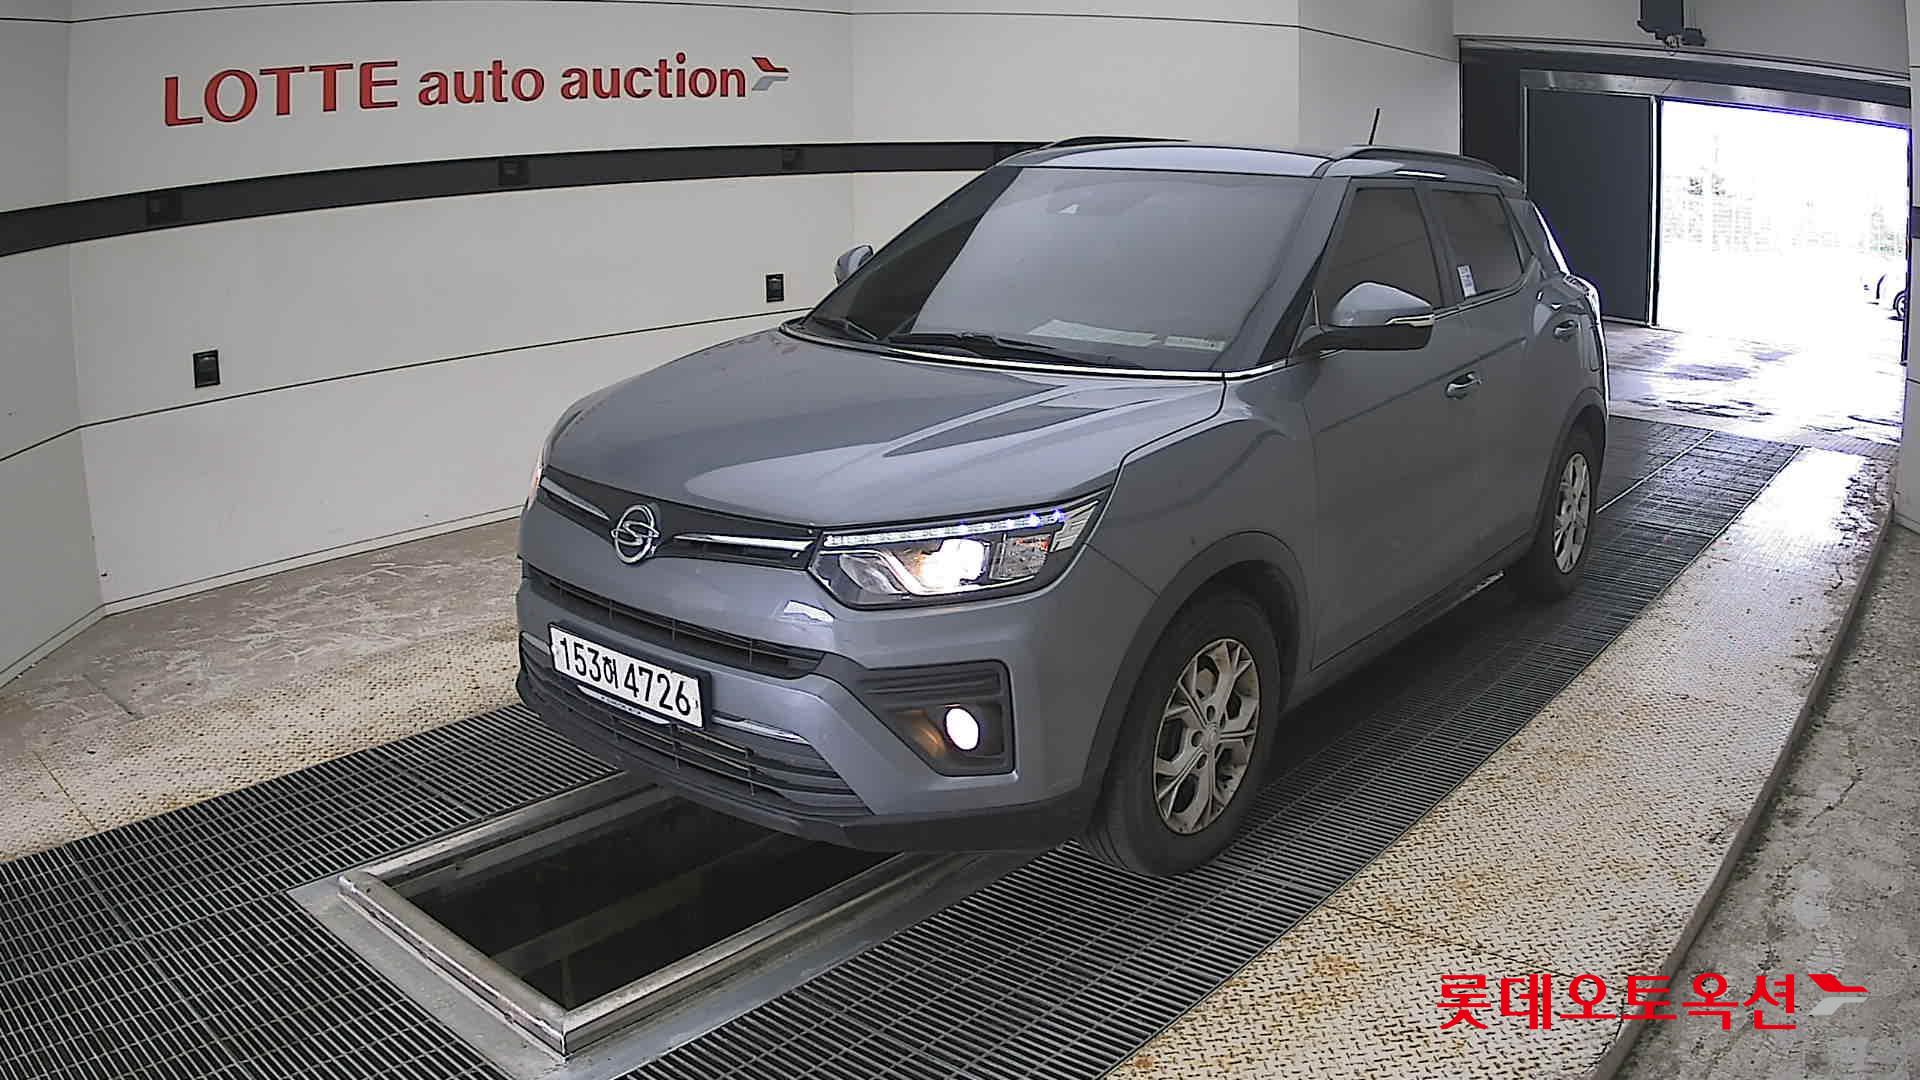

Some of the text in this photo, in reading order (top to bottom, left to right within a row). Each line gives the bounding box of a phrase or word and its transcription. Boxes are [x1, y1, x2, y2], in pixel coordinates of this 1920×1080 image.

[164, 51, 748, 126] LOTTE auto auction
